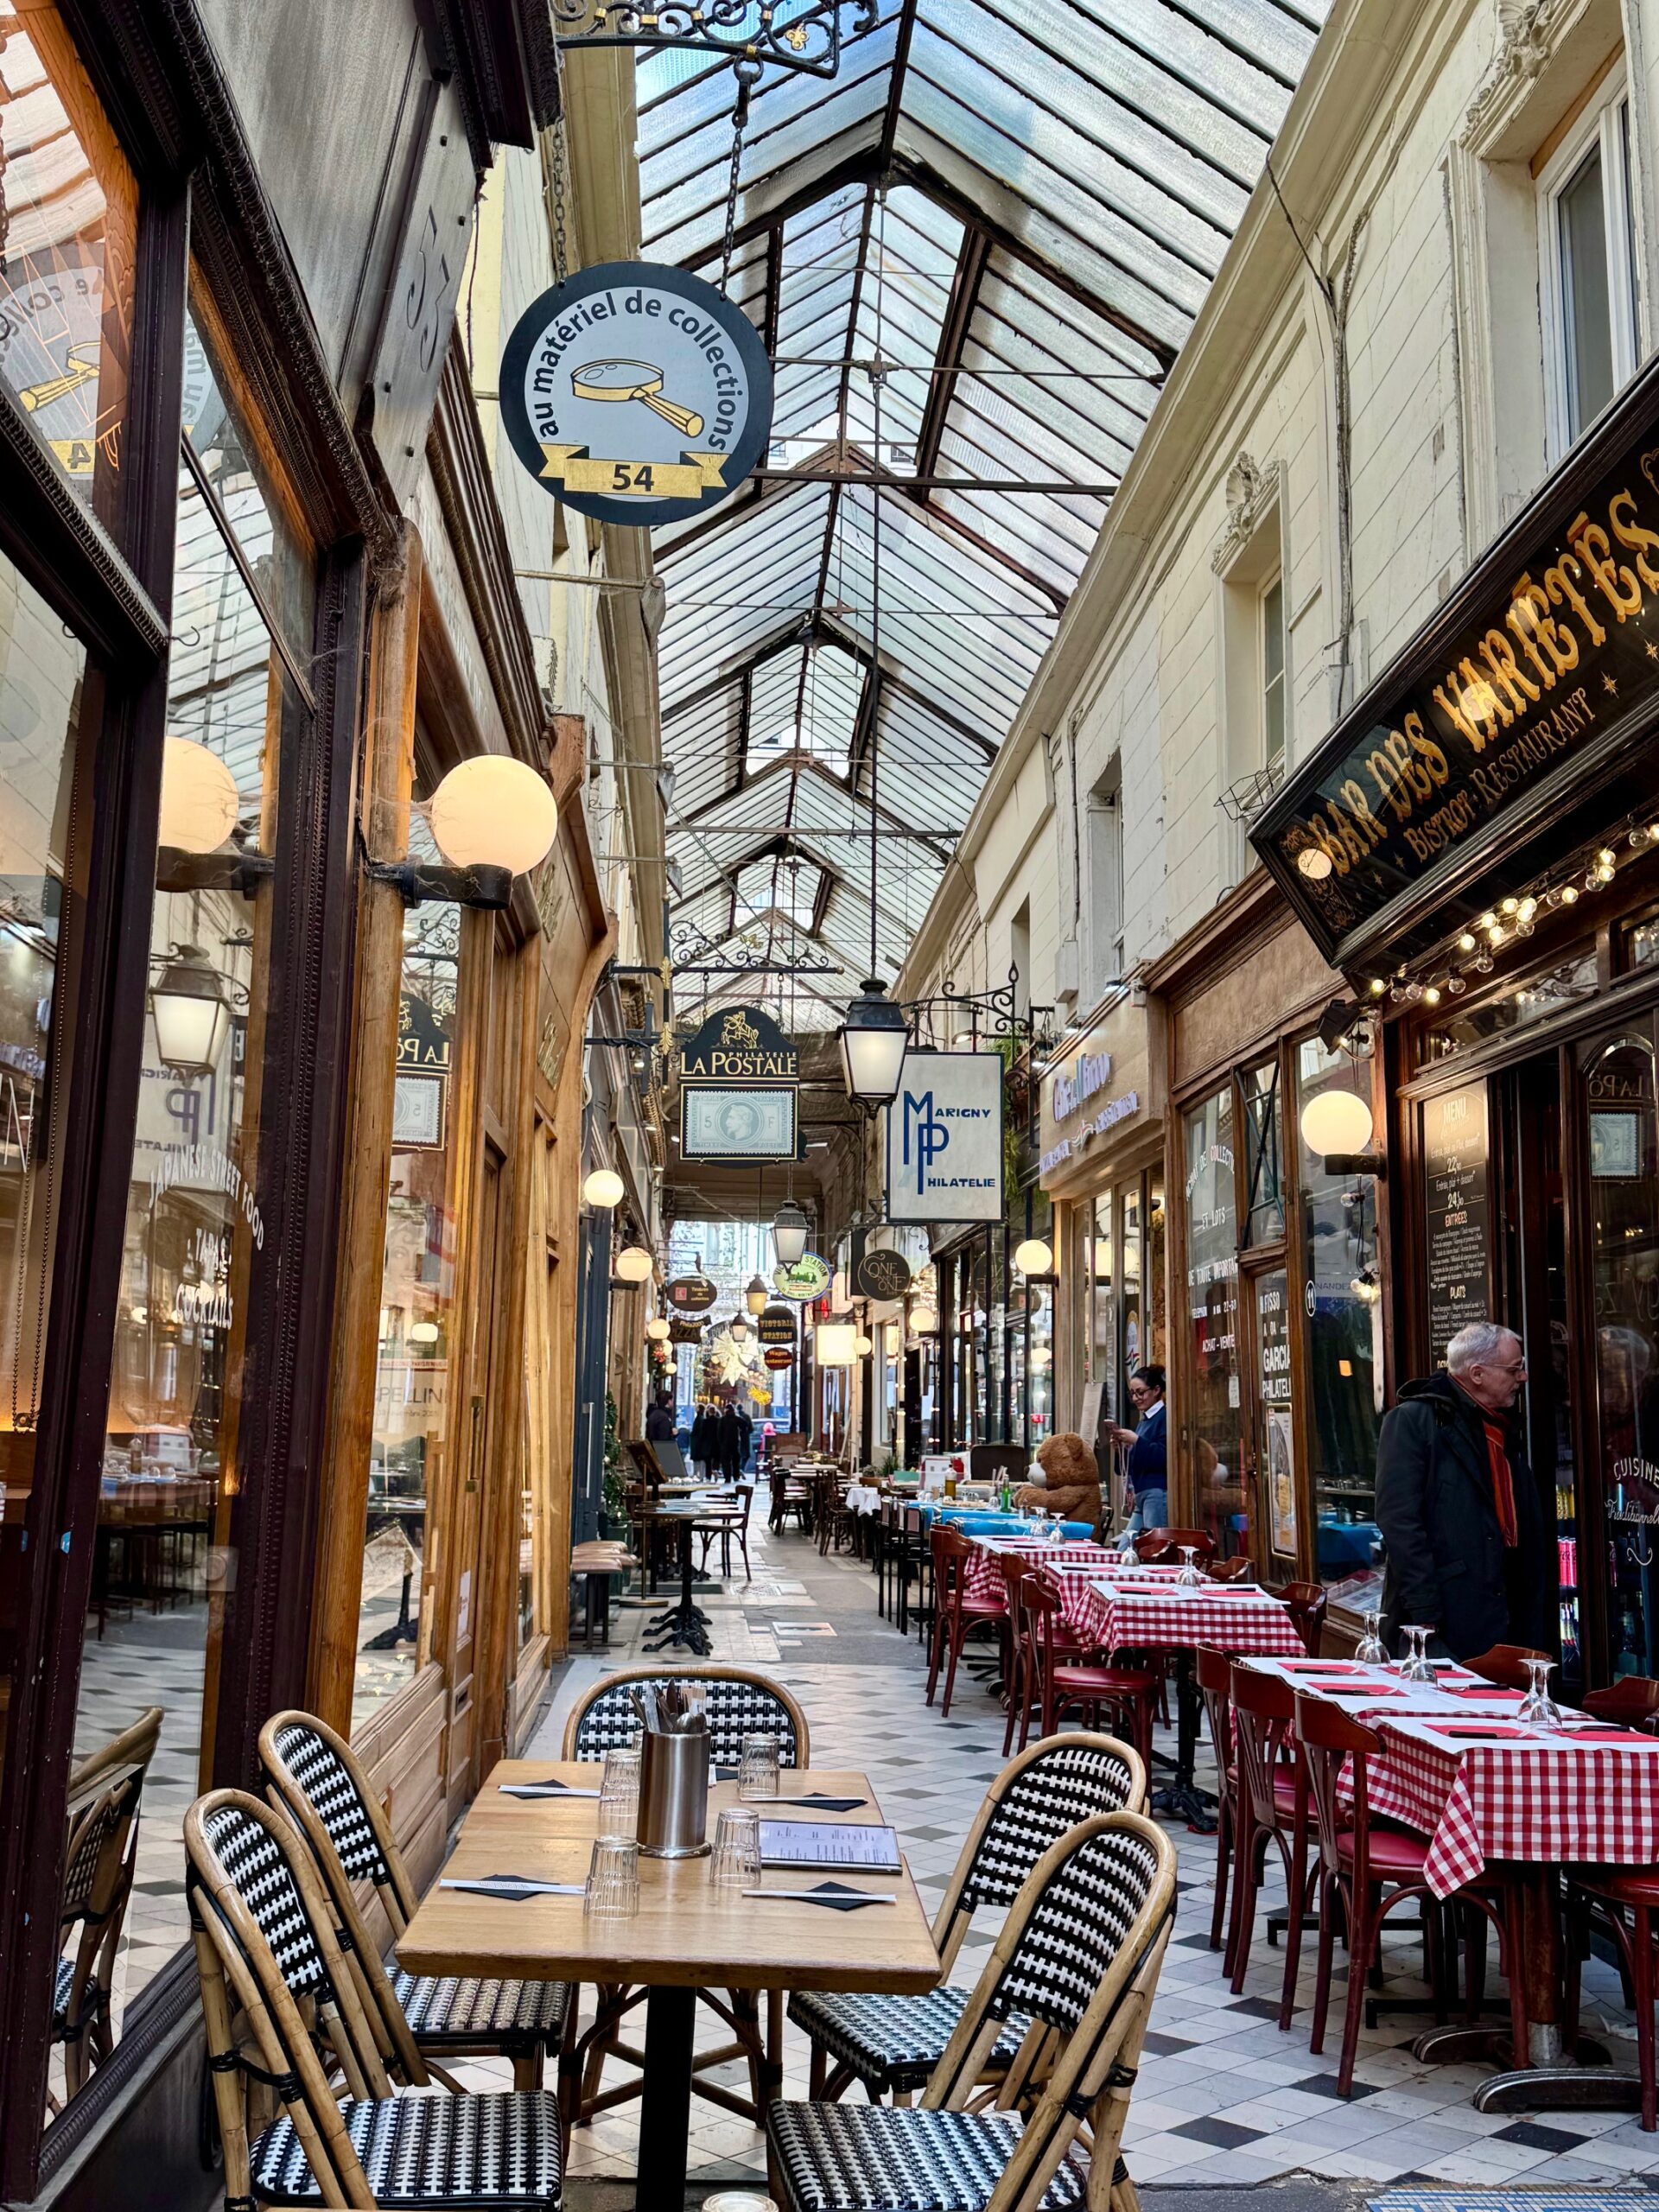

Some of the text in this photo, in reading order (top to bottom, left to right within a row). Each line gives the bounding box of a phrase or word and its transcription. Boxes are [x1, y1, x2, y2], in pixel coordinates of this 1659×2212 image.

[533, 289, 744, 451] au matériel de collections
[612, 464, 654, 493] 54
[1403, 687, 1595, 862] BISTROT RESTAURANT
[1307, 779, 1388, 877] BAR
[1365, 709, 1449, 822] DES
[681, 1052, 797, 1075] LA POSTALE
[1444, 1096, 1466, 1124] MENU
[149, 1144, 264, 1251] JAPANESE STREET FOOD
[1202, 1206, 1225, 1230] ET LOTS
[804, 1255, 828, 1277] STATION
[868, 1262, 898, 1279] ONE
[1188, 1269, 1195, 1287] DE
[1197, 1265, 1211, 1286] TOUTE
[1307, 1287, 1314, 1310] 11
[1450, 1284, 1466, 1299] PLATS
[175, 1283, 233, 1330] COCKTAILS
[760, 1319, 795, 1328] VICTORIA
[1203, 1338, 1217, 1353] ACHAT
[1219, 1333, 1236, 1350] VENTE
